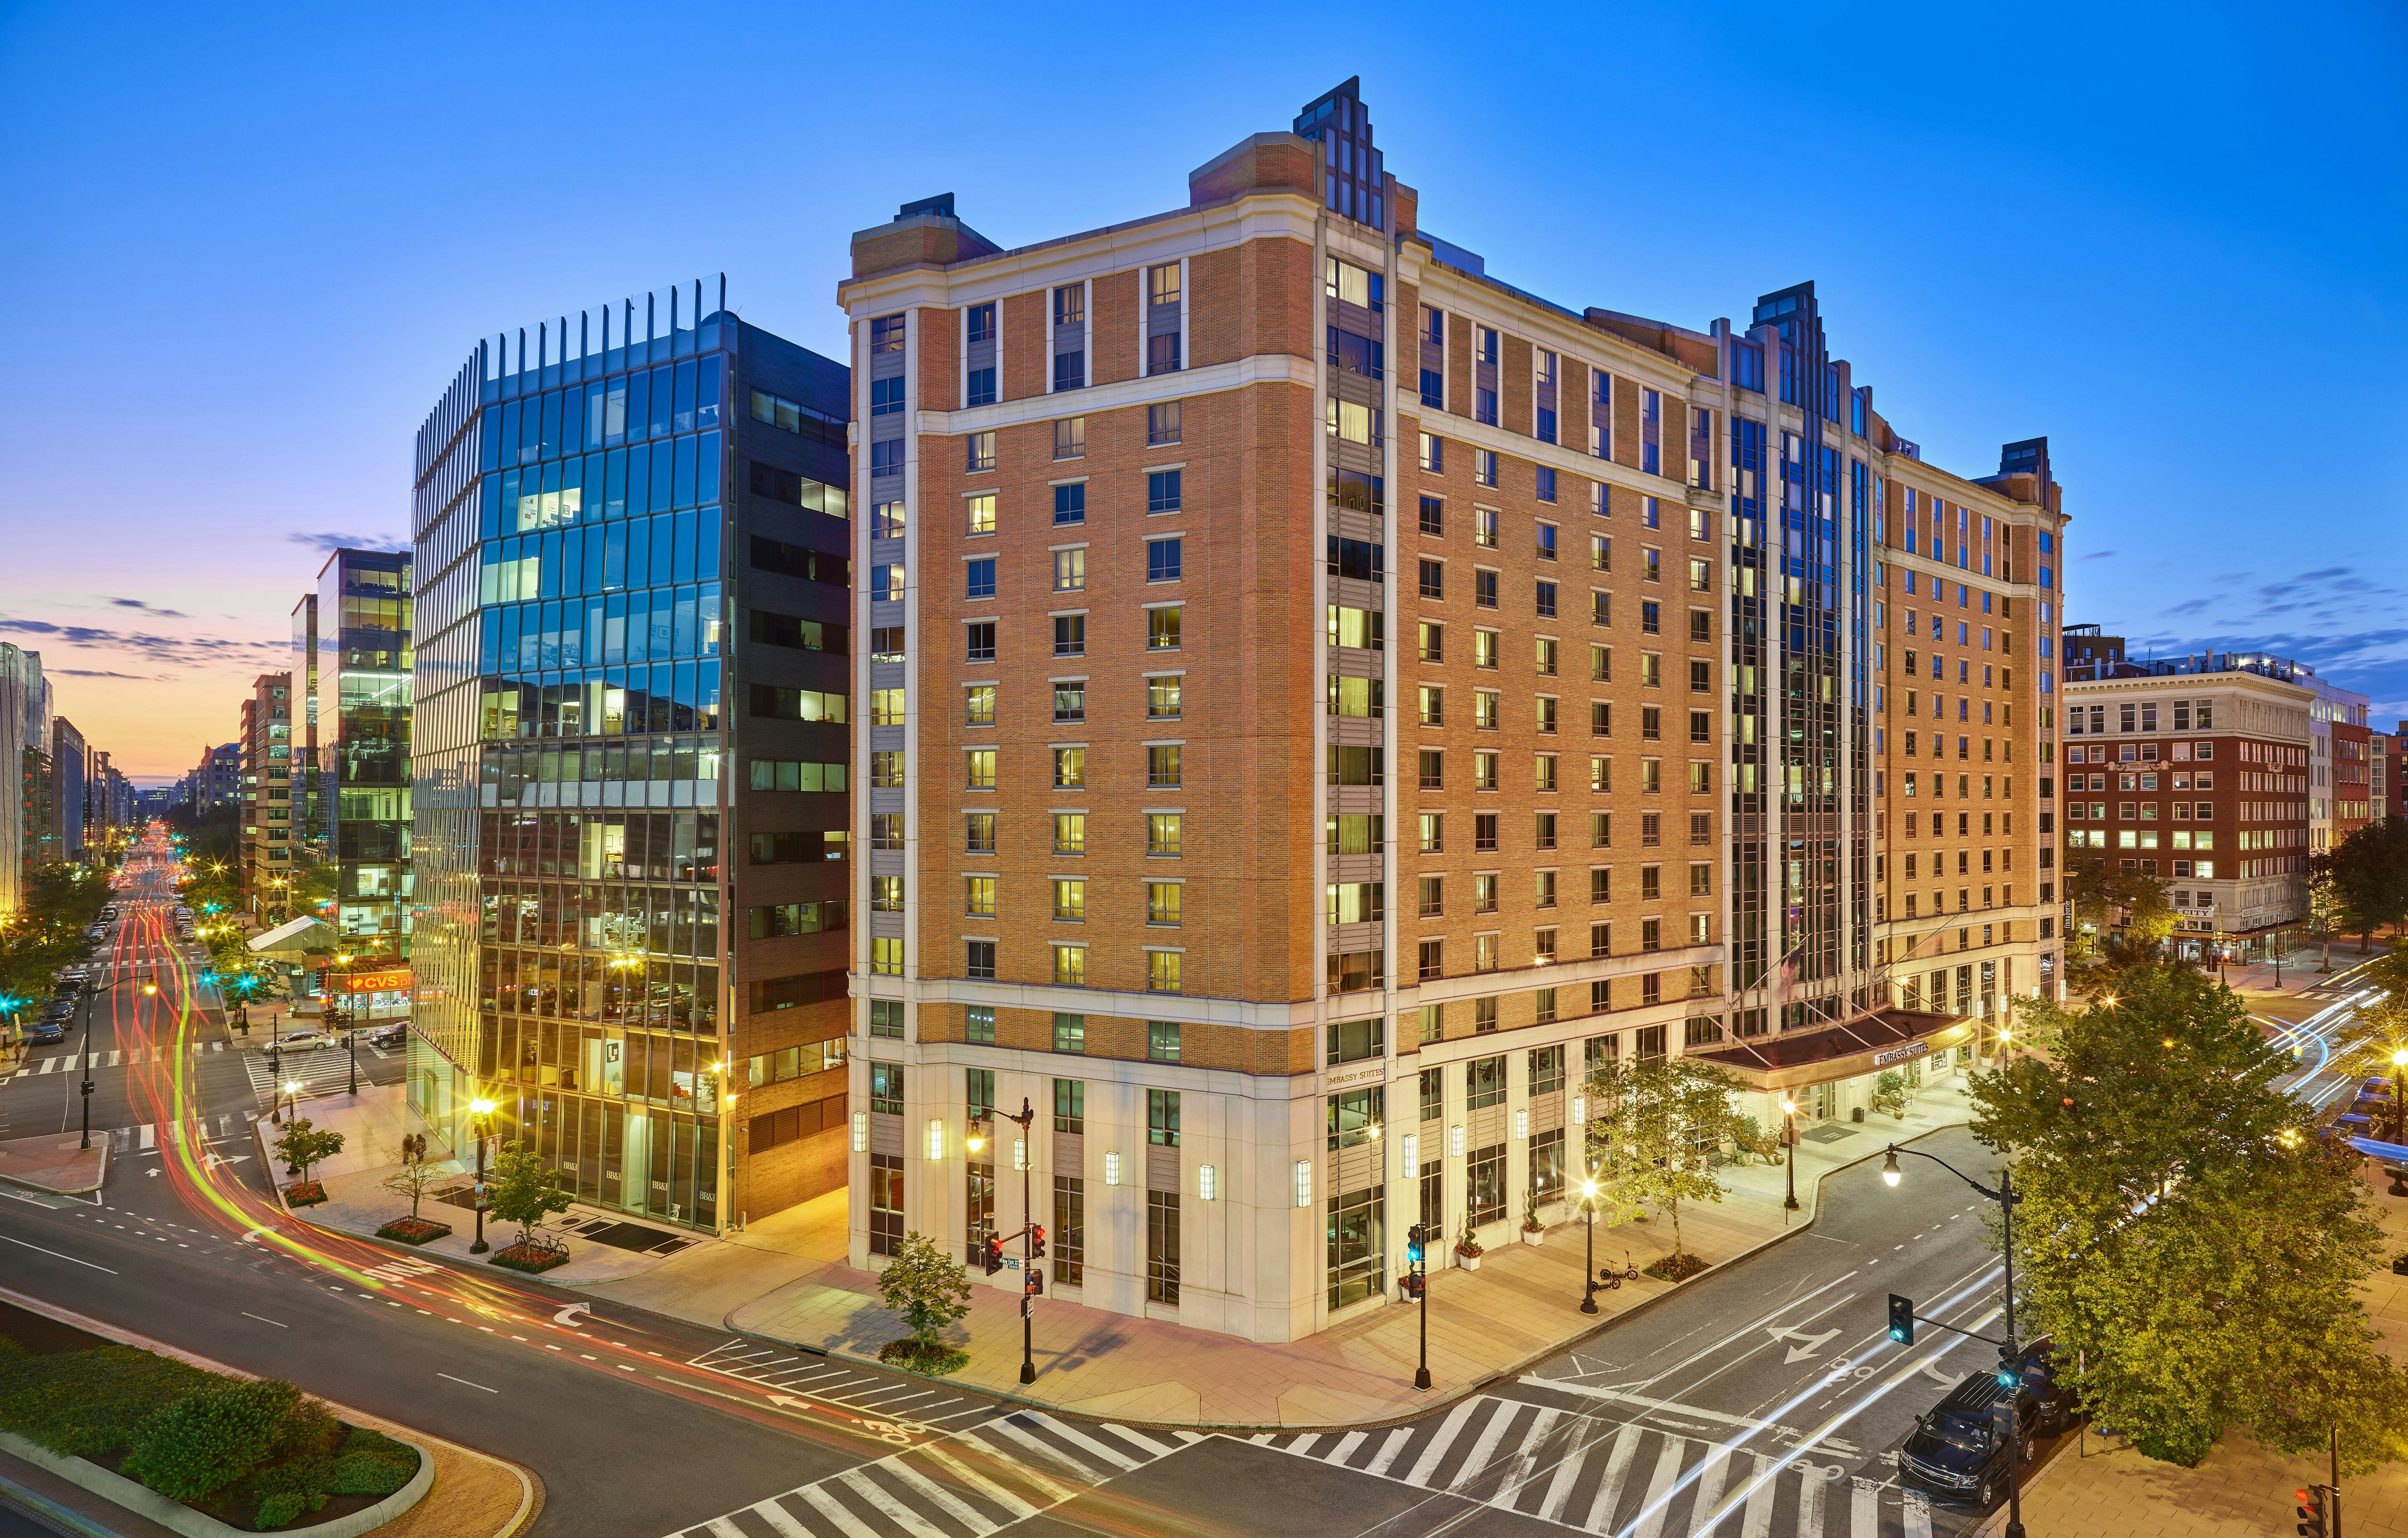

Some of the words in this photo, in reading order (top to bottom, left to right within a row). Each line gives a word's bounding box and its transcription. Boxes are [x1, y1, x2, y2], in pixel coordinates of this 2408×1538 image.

[364, 975, 399, 988] CVS
[1879, 1049, 1908, 1066] EMBASSY
[1910, 1043, 1929, 1057] SUITES
[1327, 1073, 1358, 1085] EMBASSY
[1359, 1068, 1384, 1079] SUITES
[1731, 1069, 1760, 1081] SUITES
[563, 1161, 577, 1171] BB&T
[606, 1170, 621, 1181] BB&T
[652, 1180, 668, 1191] BB&T
[700, 1191, 716, 1202] BB&T
